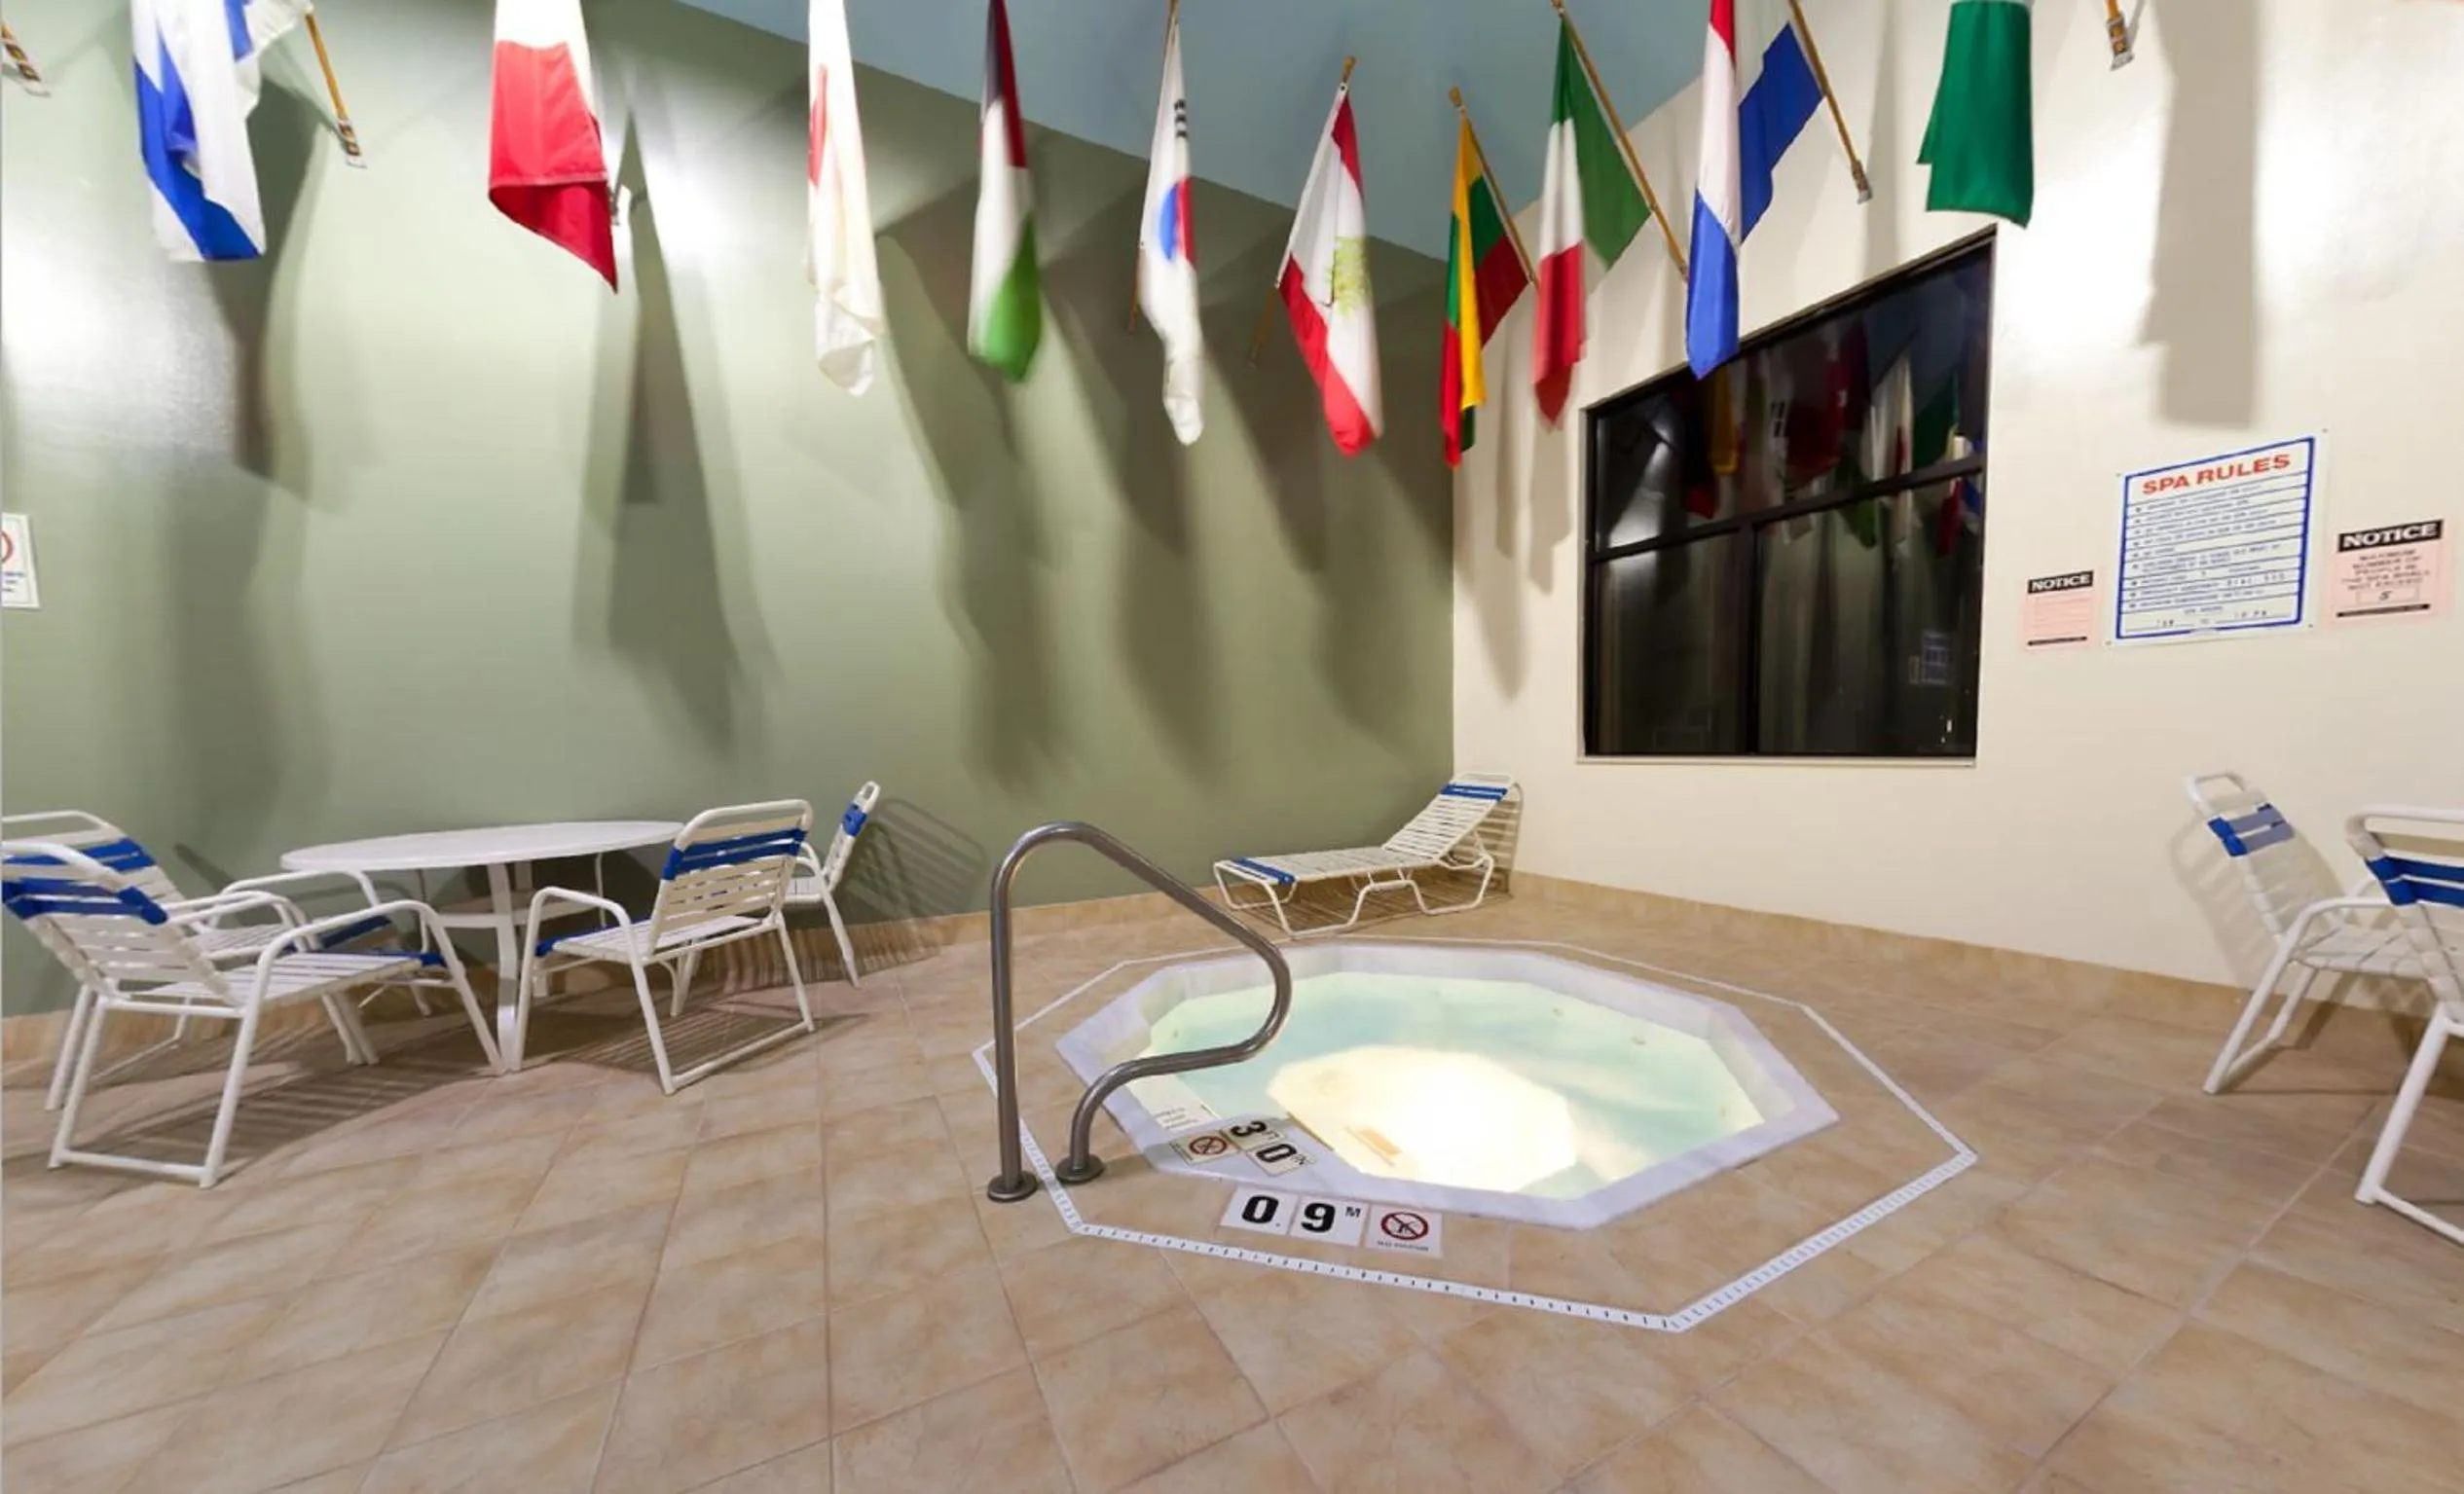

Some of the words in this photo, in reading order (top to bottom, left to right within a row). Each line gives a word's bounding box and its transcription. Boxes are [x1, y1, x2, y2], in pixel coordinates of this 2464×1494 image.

[2142, 475, 2189, 494] SPA
[2196, 454, 2291, 484] RULES
[2342, 524, 2438, 547] NOTICE
[2032, 574, 2090, 591] NOTICE
[1345, 1206, 1362, 1218] M
